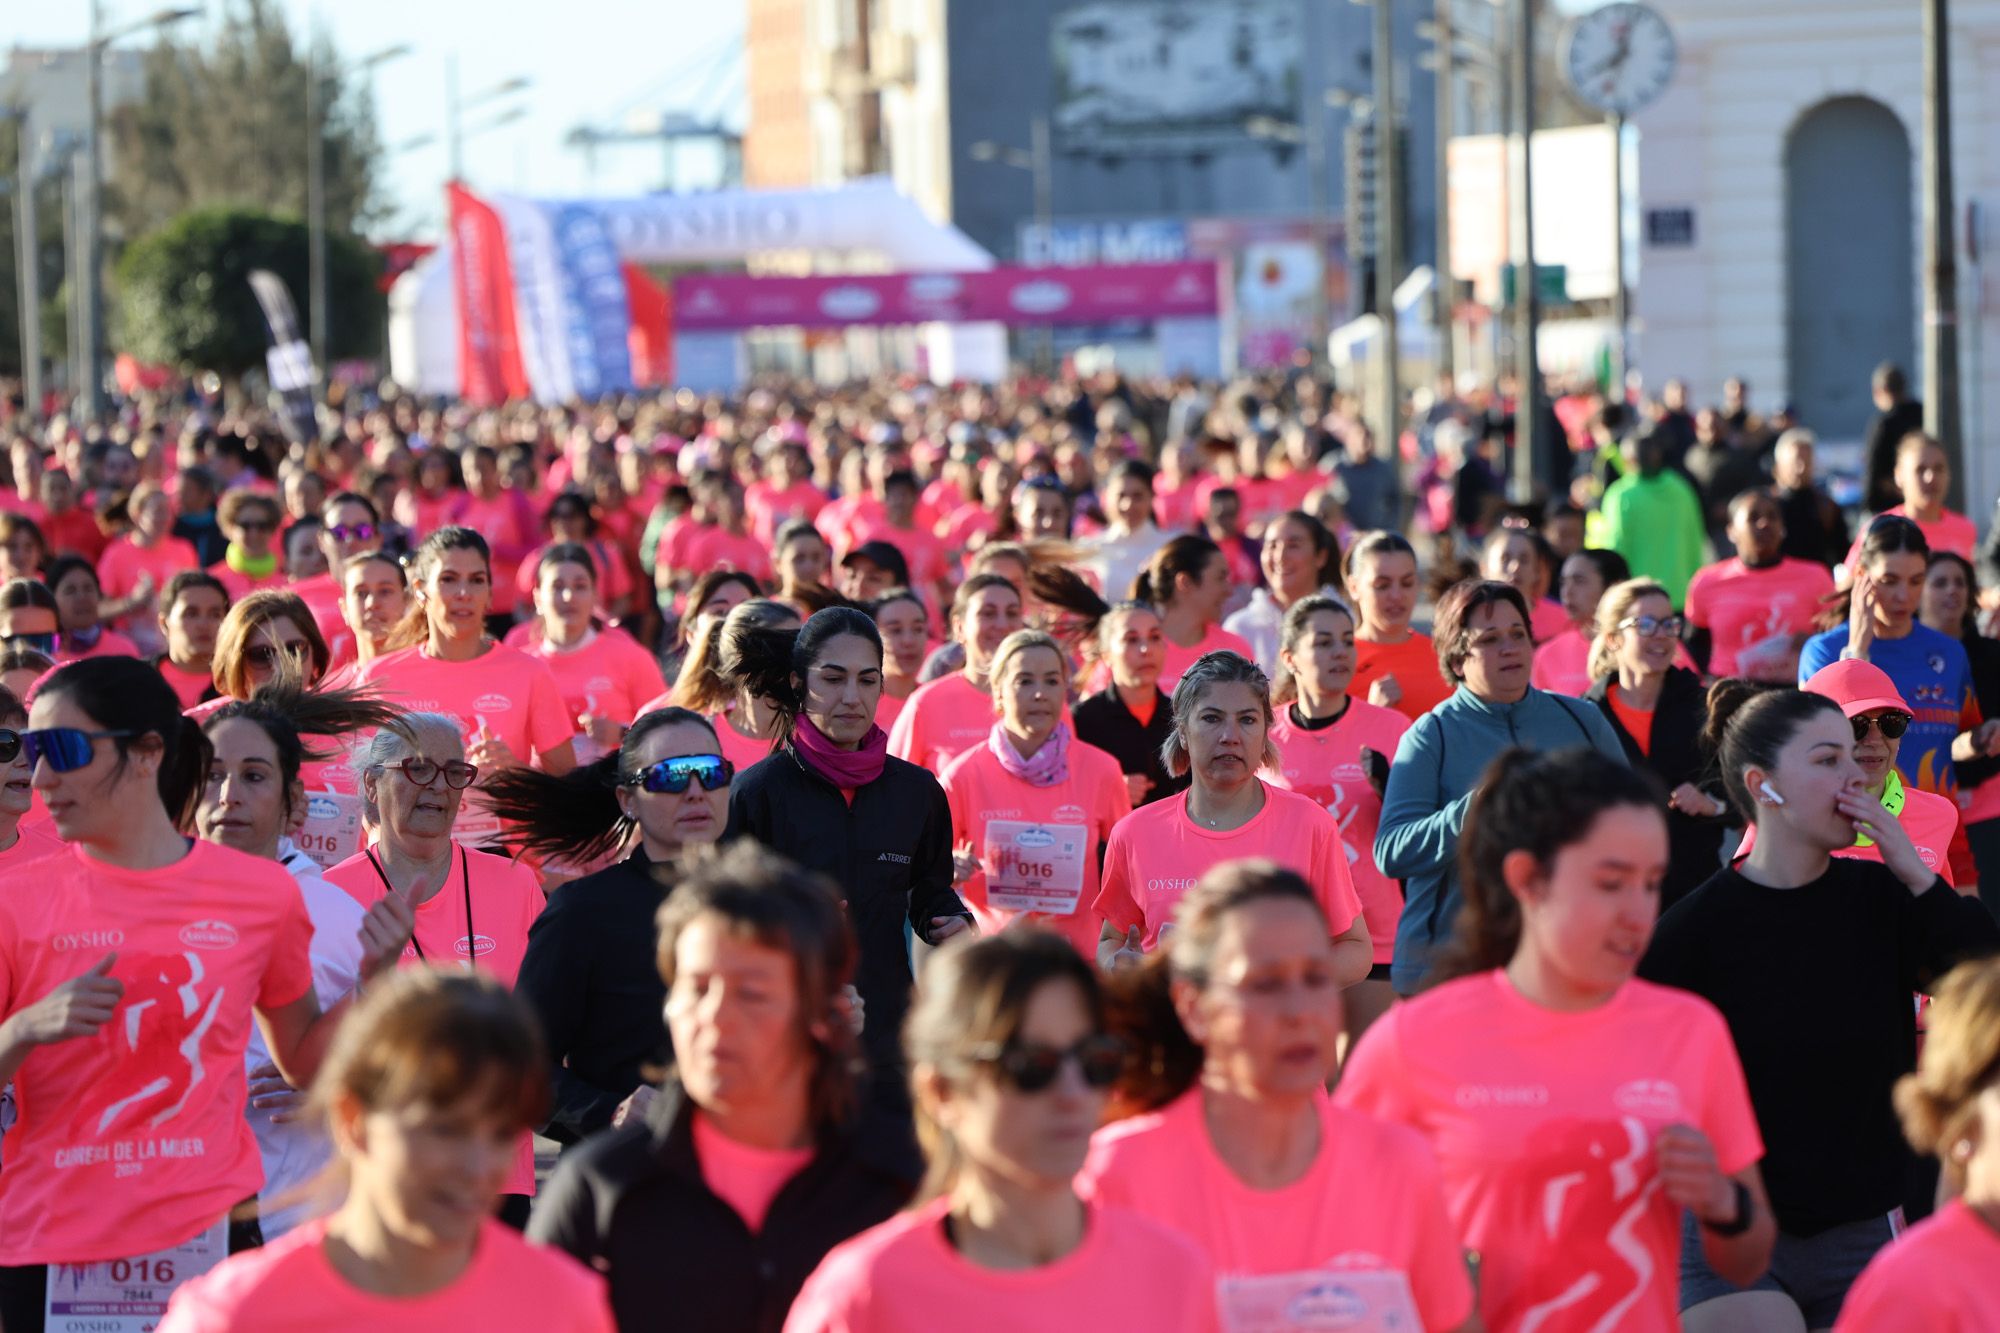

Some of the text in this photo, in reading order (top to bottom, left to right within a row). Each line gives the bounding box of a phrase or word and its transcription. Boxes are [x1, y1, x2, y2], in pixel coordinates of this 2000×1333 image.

[301, 833, 337, 852] 016
[1018, 863, 1053, 878] 016
[1148, 878, 1198, 891] OYSHO
[53, 928, 125, 953] OYSHO
[457, 942, 493, 953] ASTRIANA
[114, 1140, 134, 1161] DE
[137, 1140, 156, 1160] LA
[111, 1259, 175, 1284] 016
[66, 1321, 122, 1333] OYSHO
